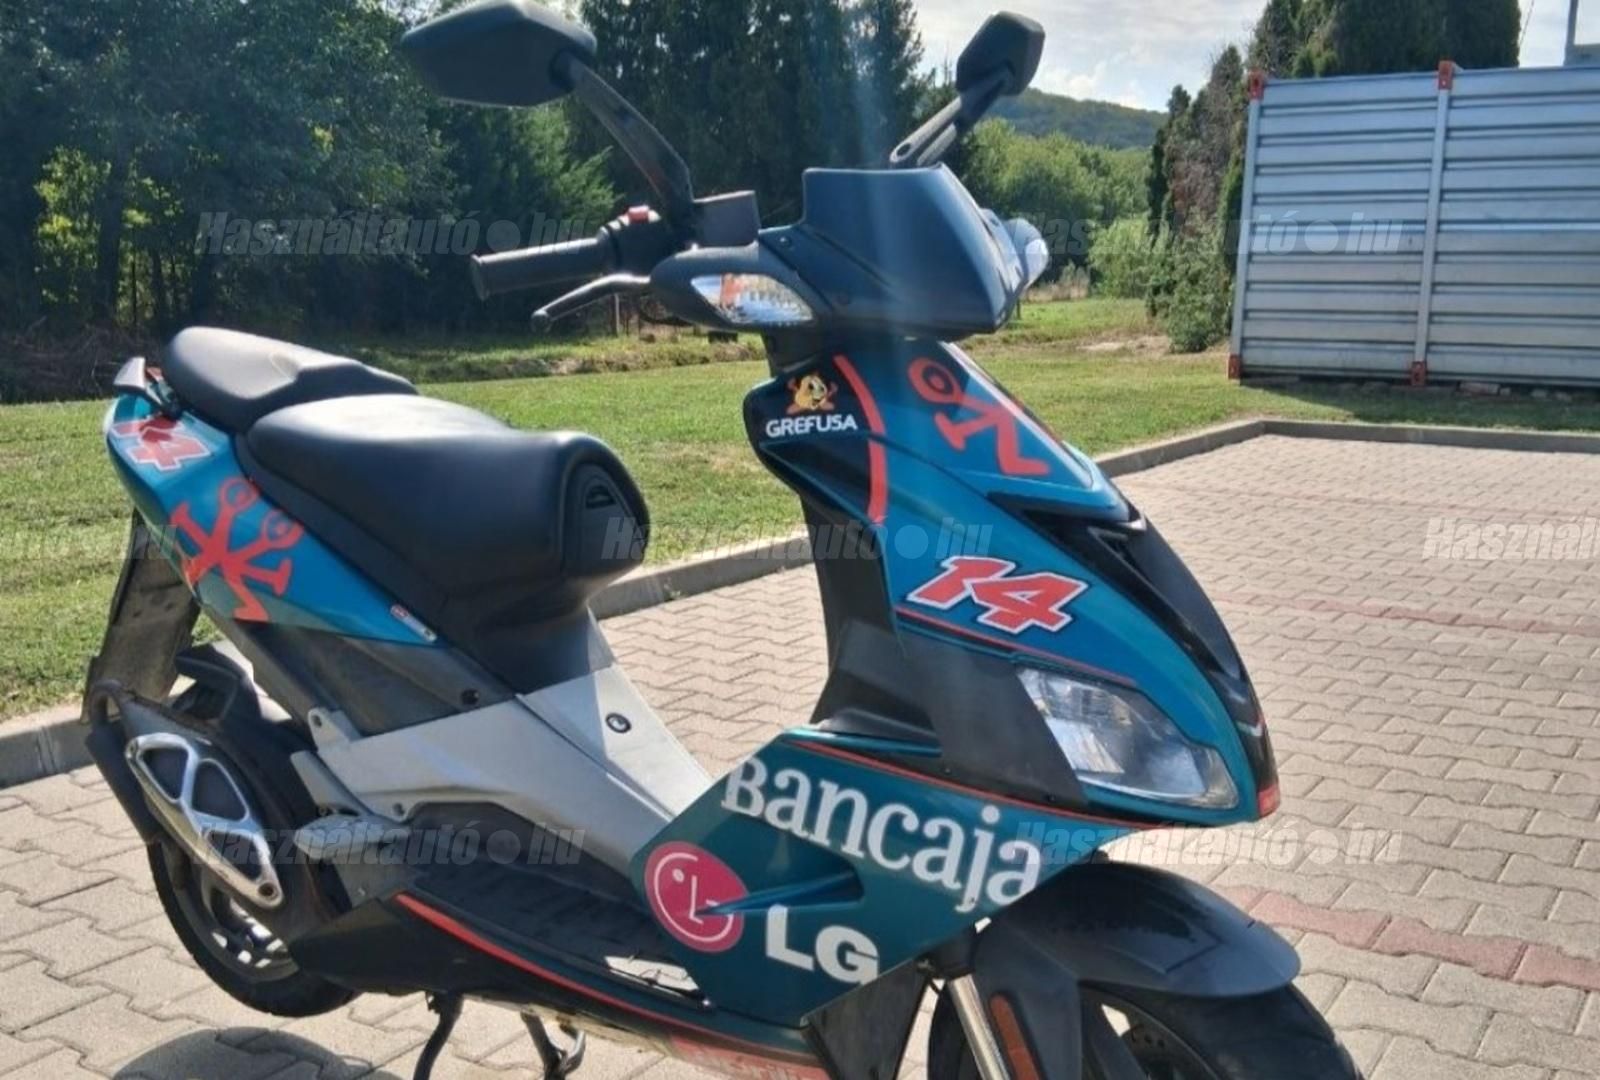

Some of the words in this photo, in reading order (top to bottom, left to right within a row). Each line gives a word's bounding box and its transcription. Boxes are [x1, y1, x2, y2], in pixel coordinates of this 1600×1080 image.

[765, 413, 858, 438] GREFUSA
[907, 555, 1089, 634] 14
[720, 756, 1042, 913] Bancaja
[765, 903, 879, 985] LG
